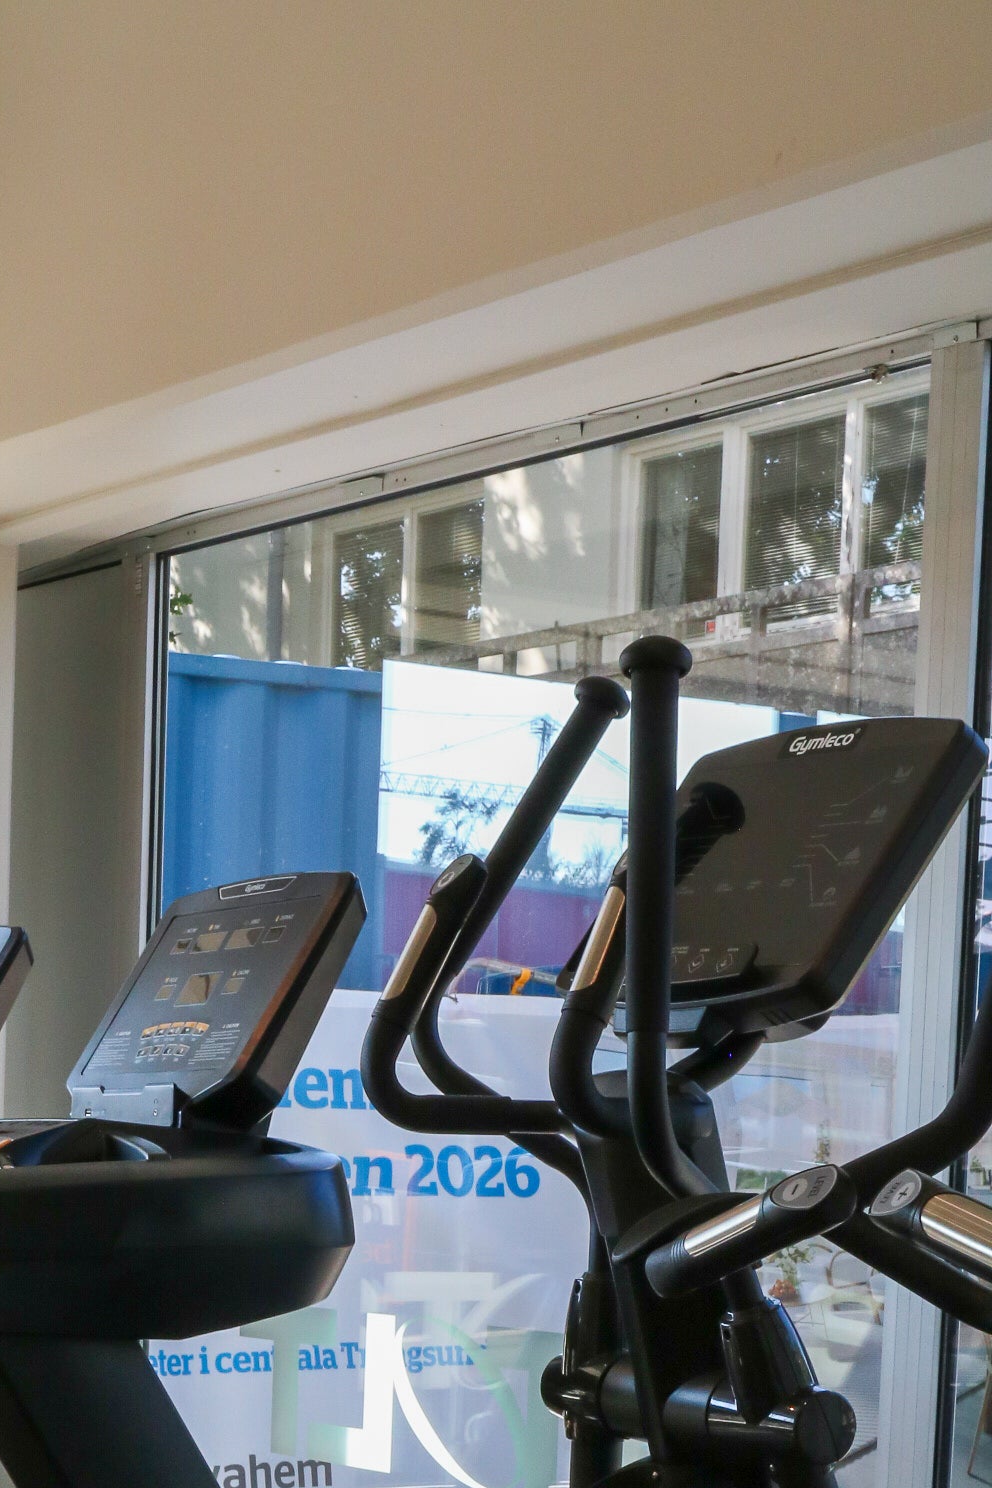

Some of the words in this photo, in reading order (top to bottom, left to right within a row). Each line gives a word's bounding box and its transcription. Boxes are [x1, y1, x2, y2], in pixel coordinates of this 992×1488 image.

[789, 733, 855, 755] Gymleco
[405, 1144, 540, 1198] 2026
[200, 1345, 210, 1375] i
